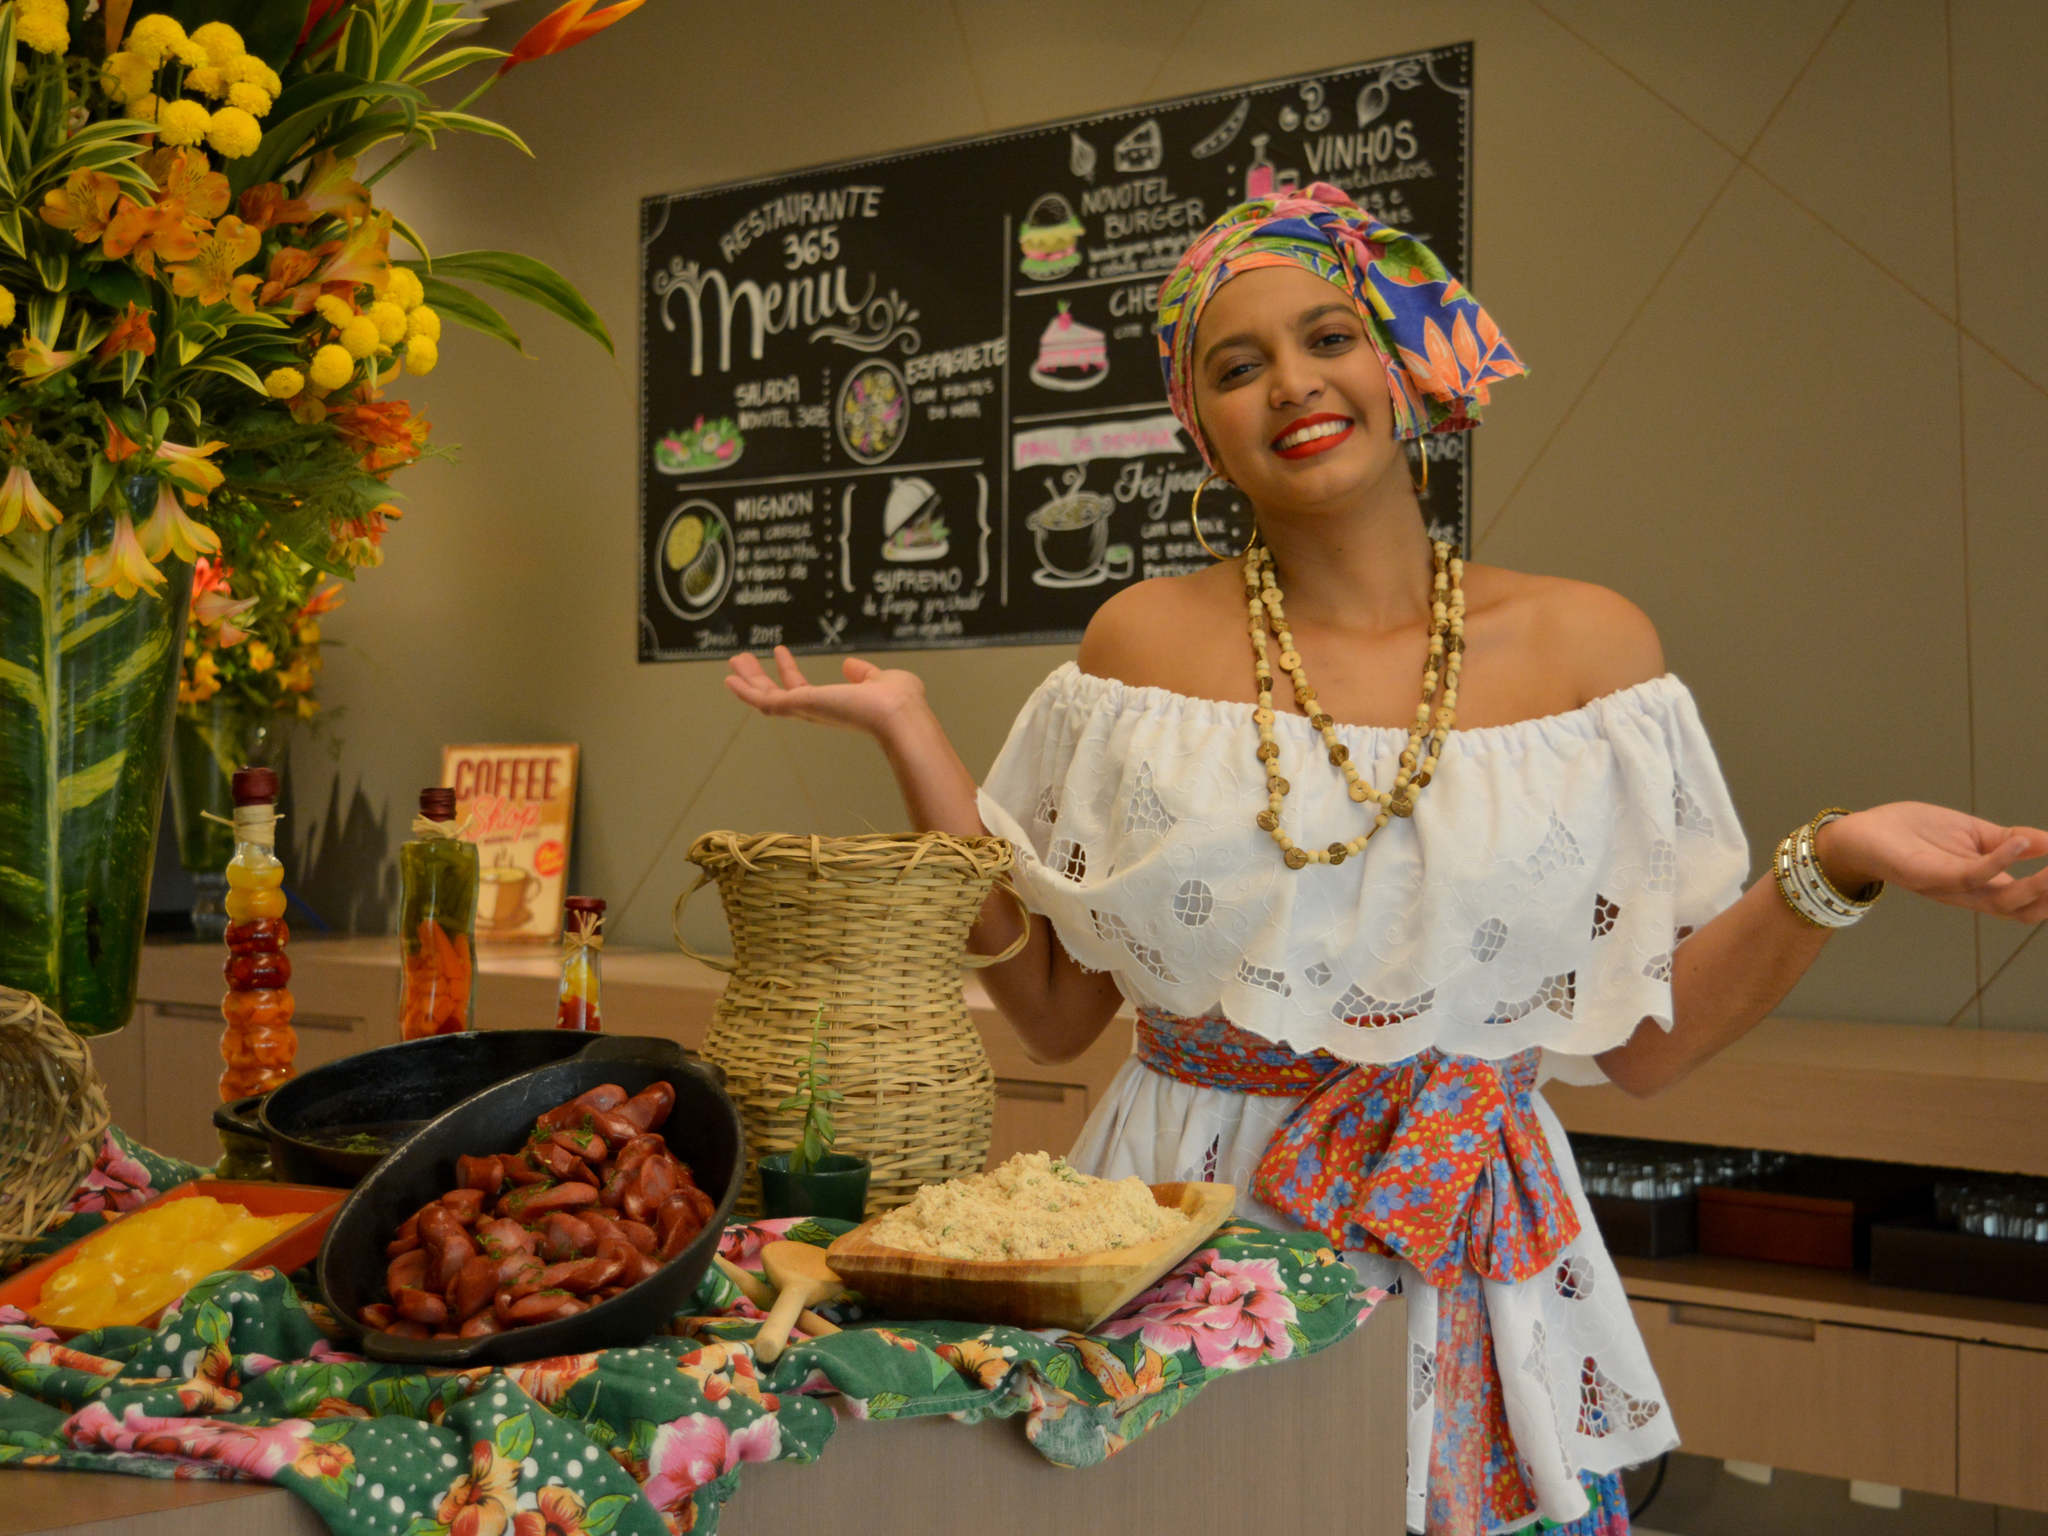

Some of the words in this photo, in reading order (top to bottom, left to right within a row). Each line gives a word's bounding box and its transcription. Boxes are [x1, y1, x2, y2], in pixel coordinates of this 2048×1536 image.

[1304, 120, 1418, 174] VINHOS
[1081, 177, 1177, 216] NOVOTEL
[1104, 198, 1207, 239] BURGER
[720, 185, 883, 262] RESTAURANTE
[784, 225, 840, 270] 365
[656, 260, 876, 376] Menu
[735, 489, 813, 521] MIGNON
[872, 566, 963, 593] SUPREMO
[456, 758, 561, 801] COFFEE
[466, 791, 541, 843] Shop
